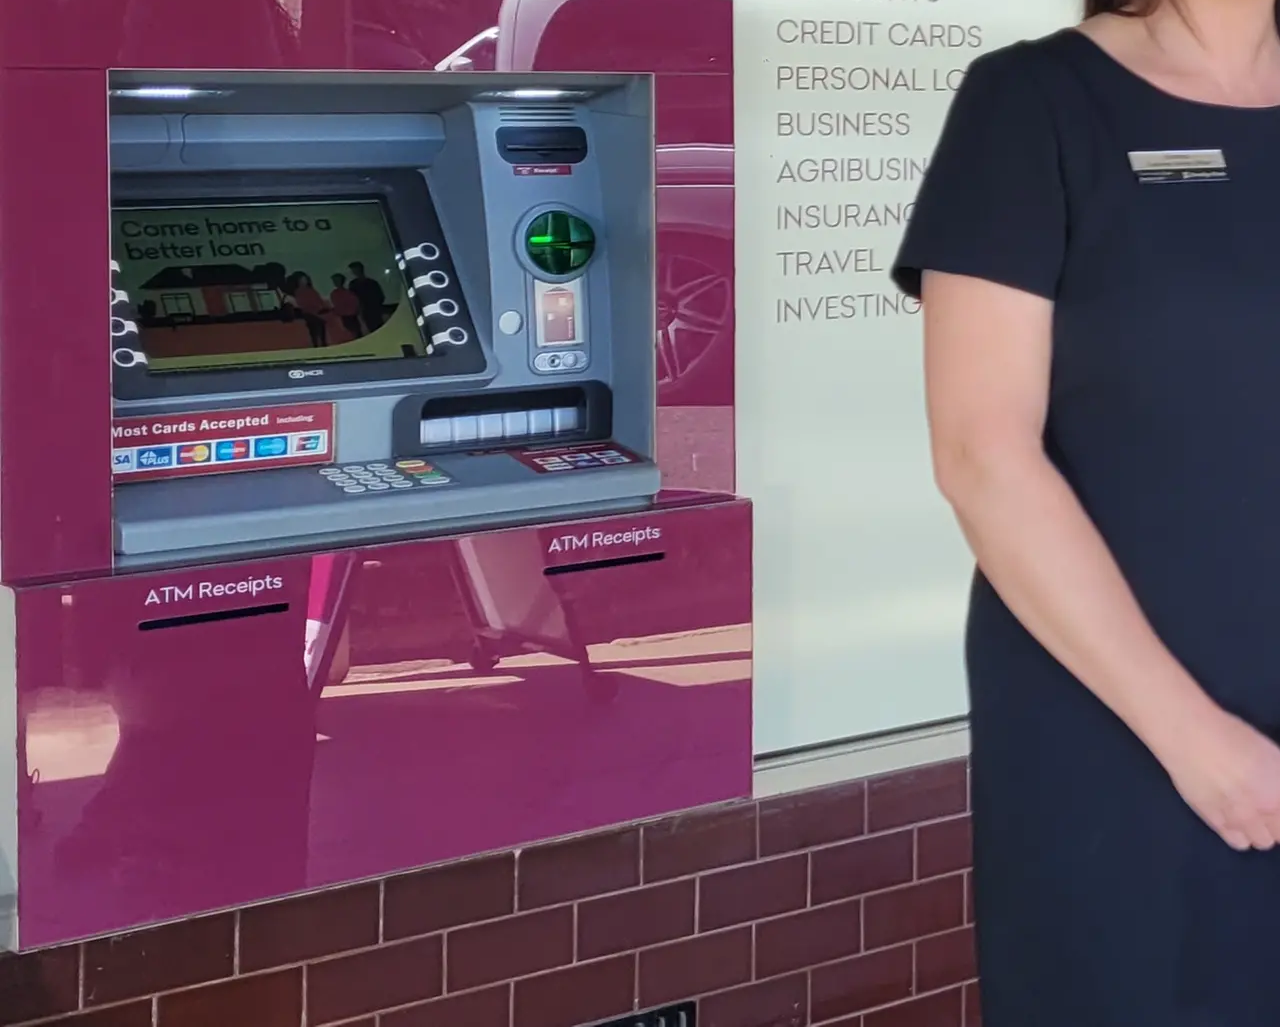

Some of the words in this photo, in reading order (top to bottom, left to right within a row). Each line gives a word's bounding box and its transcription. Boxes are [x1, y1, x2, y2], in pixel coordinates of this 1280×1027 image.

[777, 19, 881, 46] CREDIT
[888, 23, 983, 48] CARDS
[777, 66, 926, 91] PERSONAL
[777, 112, 911, 137] BUSINESS
[776, 157, 928, 184] AGRIBUSIN
[120, 220, 200, 238] Come
[204, 217, 277, 236] home
[282, 216, 309, 233] to
[314, 218, 332, 231] a
[124, 241, 203, 260] better
[209, 239, 266, 258] loan
[776, 249, 884, 276] TRAVEL
[777, 293, 922, 324] INVESTING
[112, 424, 149, 438] Most
[152, 420, 196, 435] Cards
[199, 413, 269, 430] Accepted
[549, 531, 588, 554] ATM
[593, 525, 661, 549] Receipts
[145, 584, 194, 607] ATM
[198, 576, 283, 600] Receipts
